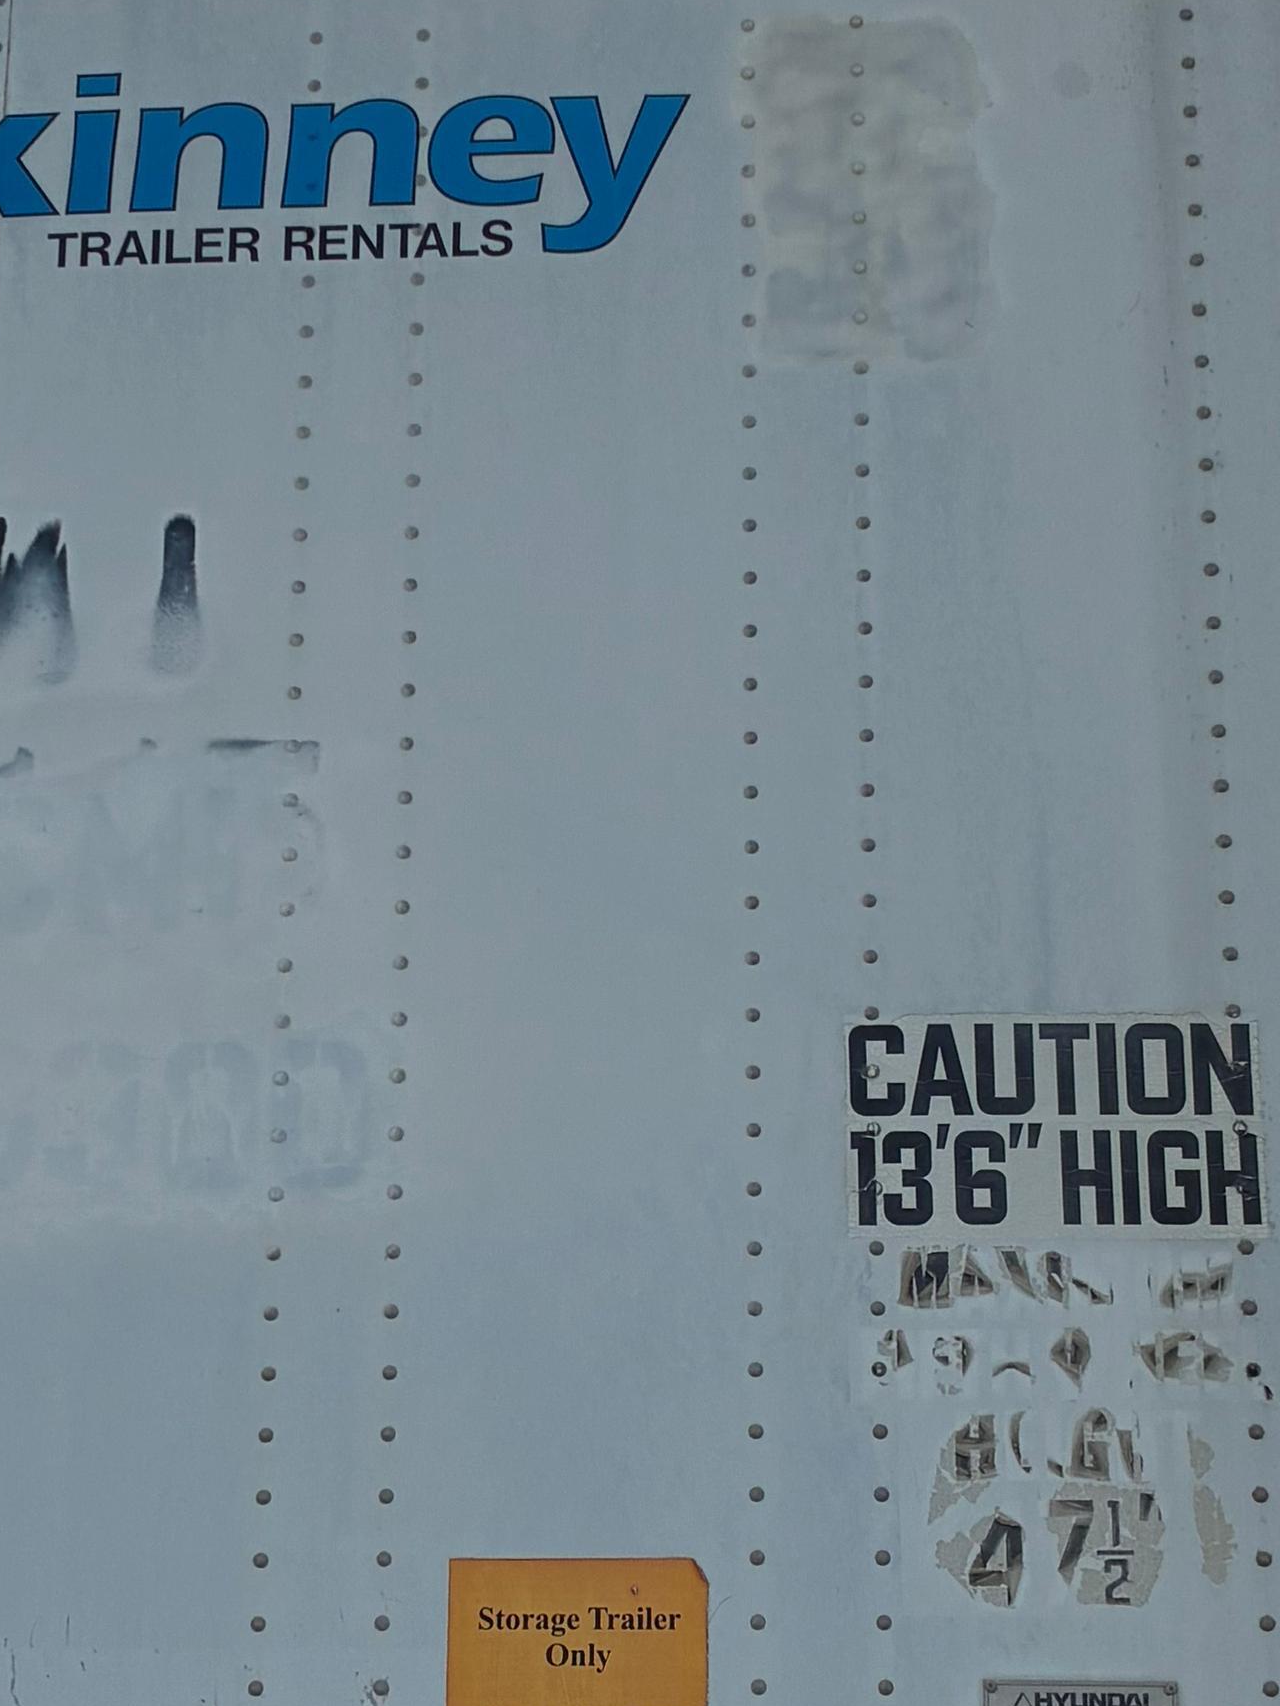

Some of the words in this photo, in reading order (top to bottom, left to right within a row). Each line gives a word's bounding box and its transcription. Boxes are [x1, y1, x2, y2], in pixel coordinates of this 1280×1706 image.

[47, 226, 261, 268] TRAILER
[284, 219, 514, 261] RENTALS
[848, 1022, 1255, 1117] CAUTION
[850, 1122, 1043, 1226] 13'6"
[1060, 1128, 1263, 1226] HIGH
[478, 1607, 580, 1637] Storage
[588, 1606, 681, 1631] Trailer
[546, 1644, 611, 1673] Only
